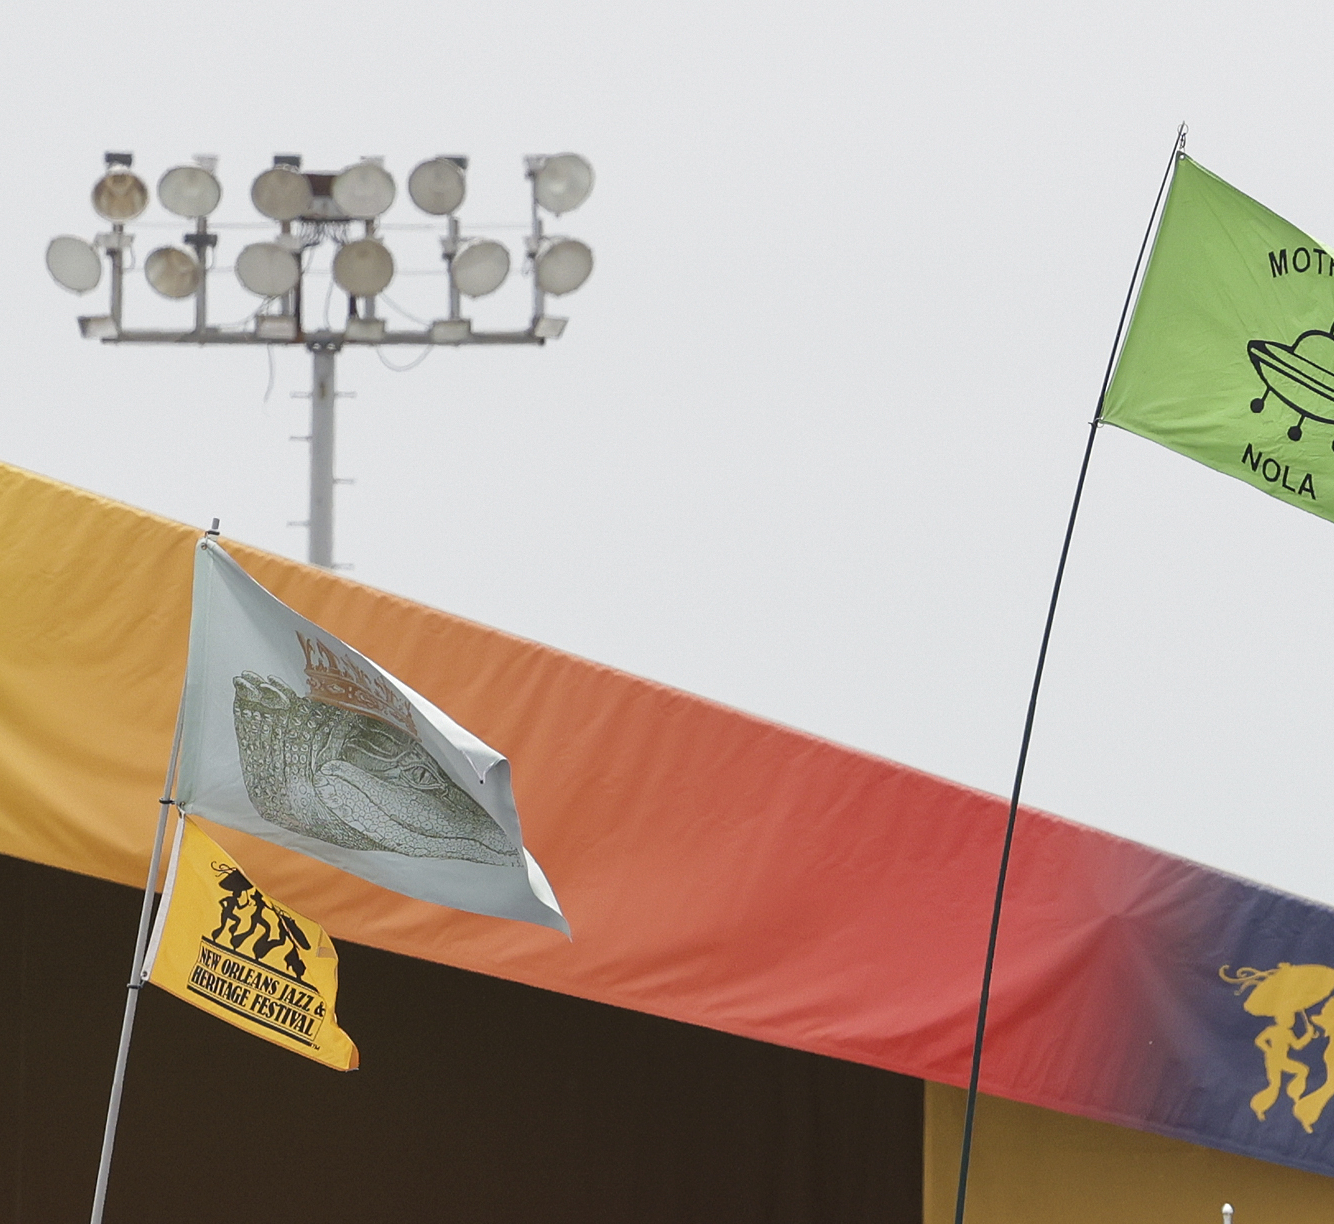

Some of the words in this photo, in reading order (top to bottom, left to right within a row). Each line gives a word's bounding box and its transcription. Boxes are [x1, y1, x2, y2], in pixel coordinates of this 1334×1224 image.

[1241, 444, 1316, 500] NOLA
[191, 965, 250, 1007] HERITAGE
[250, 995, 315, 1036] FESTIVAL
[200, 947, 221, 970] NEW
[221, 959, 279, 996] ORLEANS
[278, 984, 314, 1014] JAZZ
[314, 1001, 325, 1017] &
